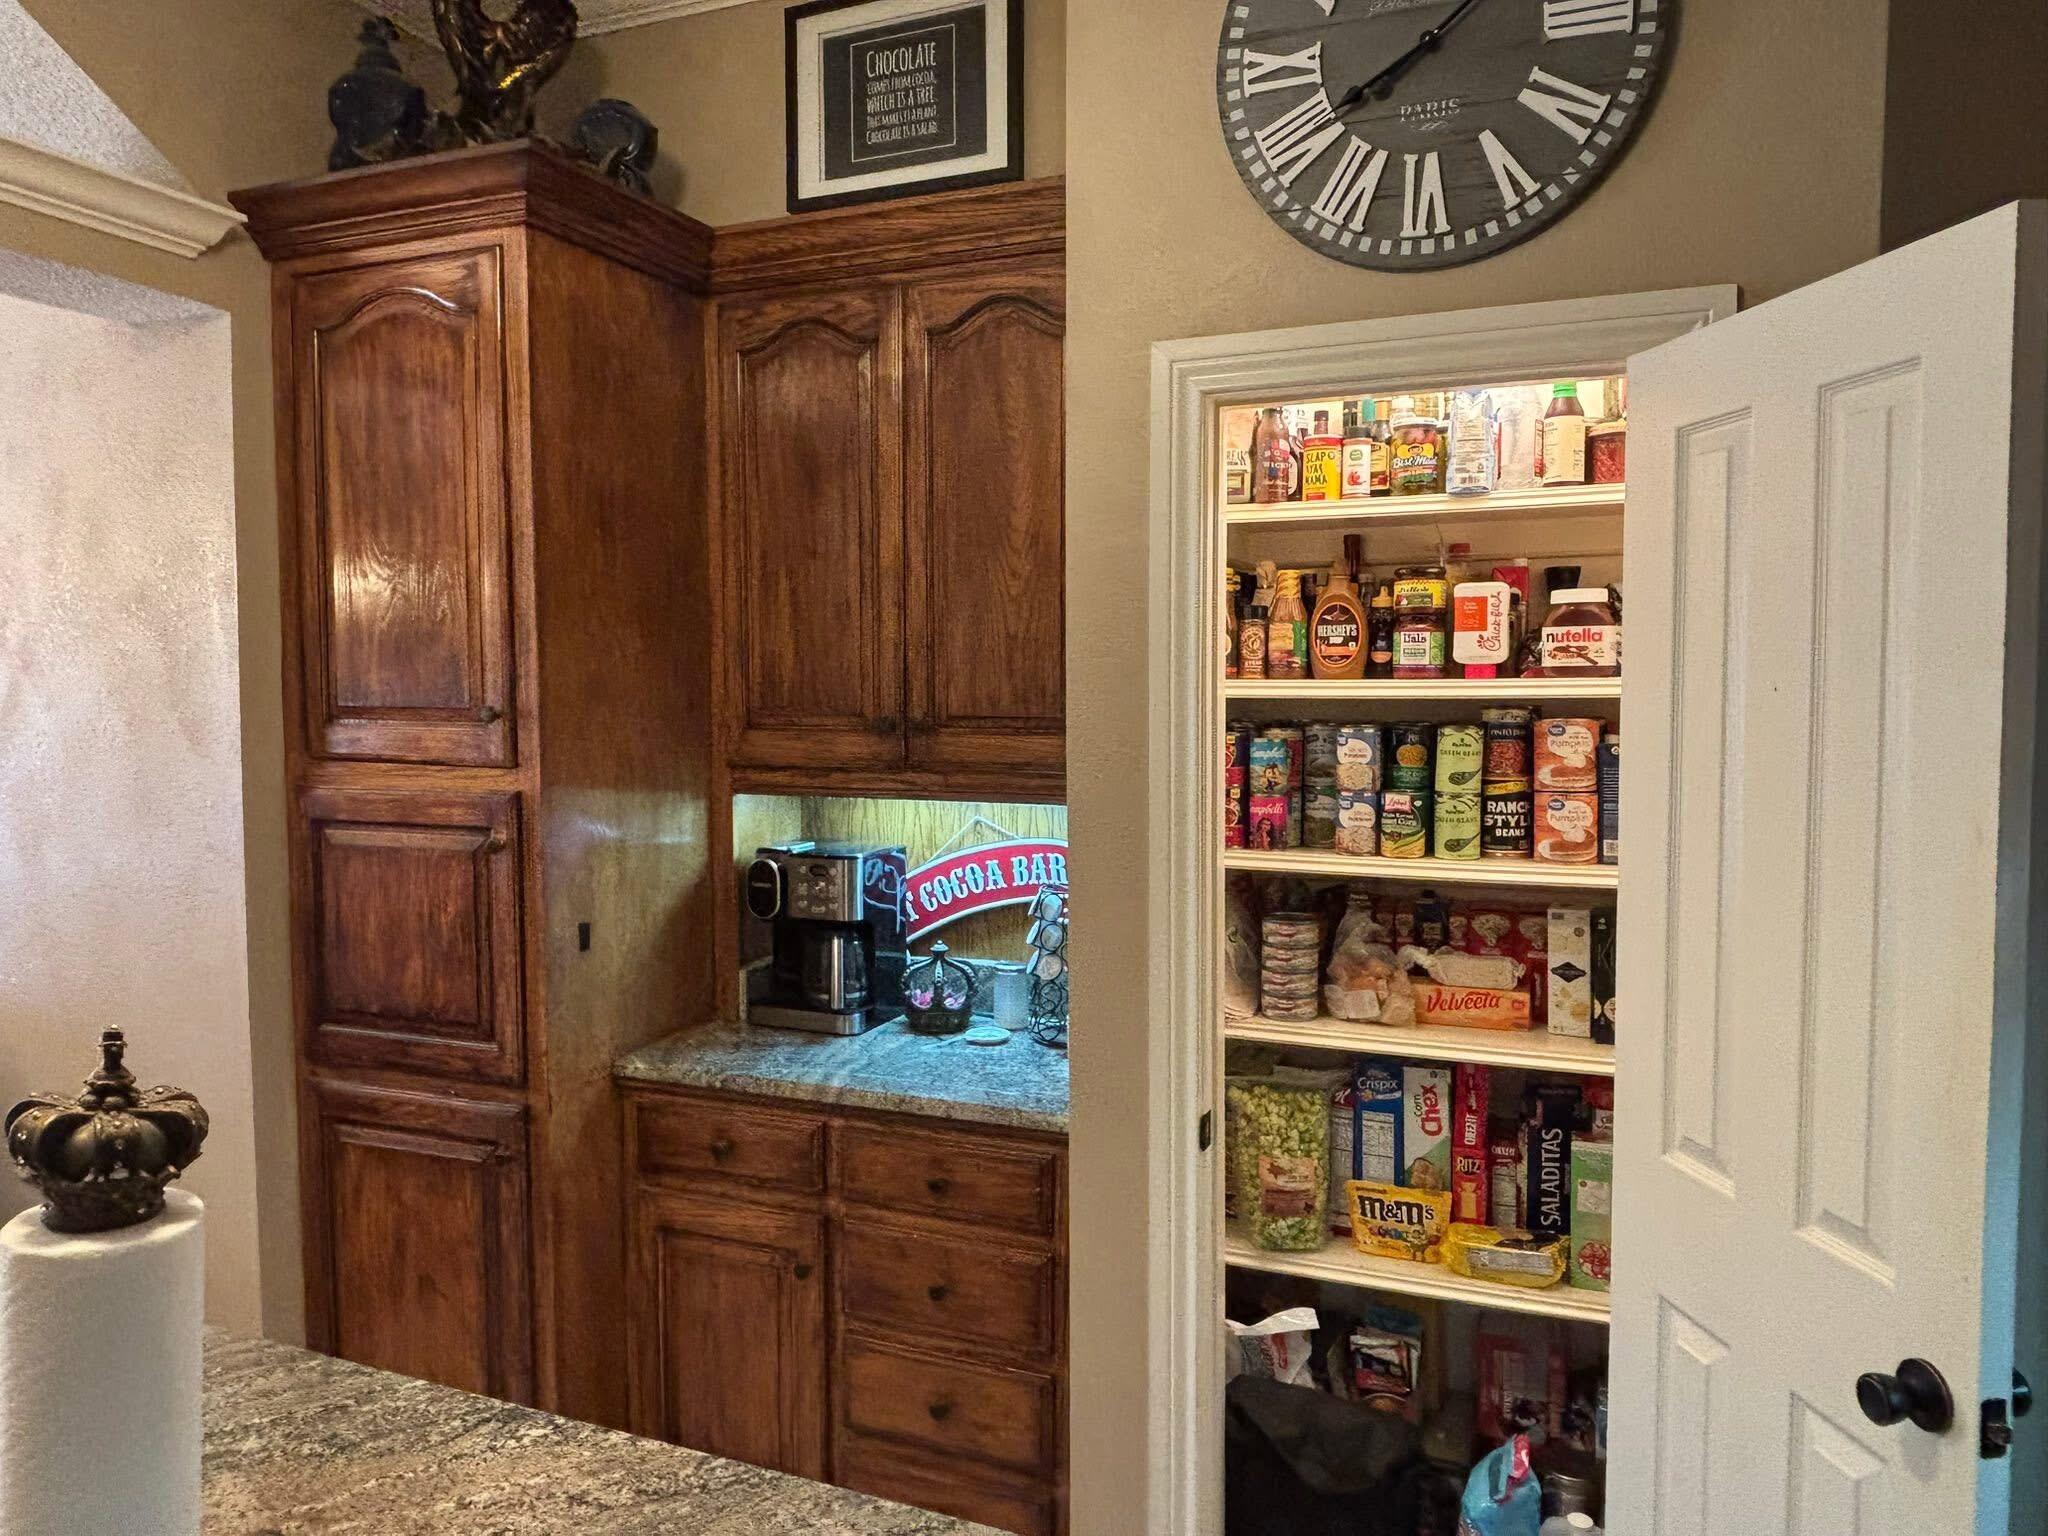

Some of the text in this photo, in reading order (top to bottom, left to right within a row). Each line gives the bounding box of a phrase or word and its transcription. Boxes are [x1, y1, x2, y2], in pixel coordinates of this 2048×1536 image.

[867, 42, 936, 78] CHOCOLATE
[867, 93, 895, 113] WHICH
[896, 91, 905, 108] IS
[908, 89, 914, 106] A
[1306, 451, 1326, 464] SLAP
[1318, 624, 1358, 637] HERSHEY'S
[1546, 628, 1604, 644] nutella
[1484, 815, 1528, 827] STYL
[919, 860, 1007, 912] COCOA
[1010, 853, 1068, 887] BAR
[1426, 987, 1503, 1014] Velveeta
[1357, 1077, 1399, 1092] Crispix
[1456, 1156, 1480, 1174] RITZ
[1540, 1127, 1563, 1226] SALADITAS
